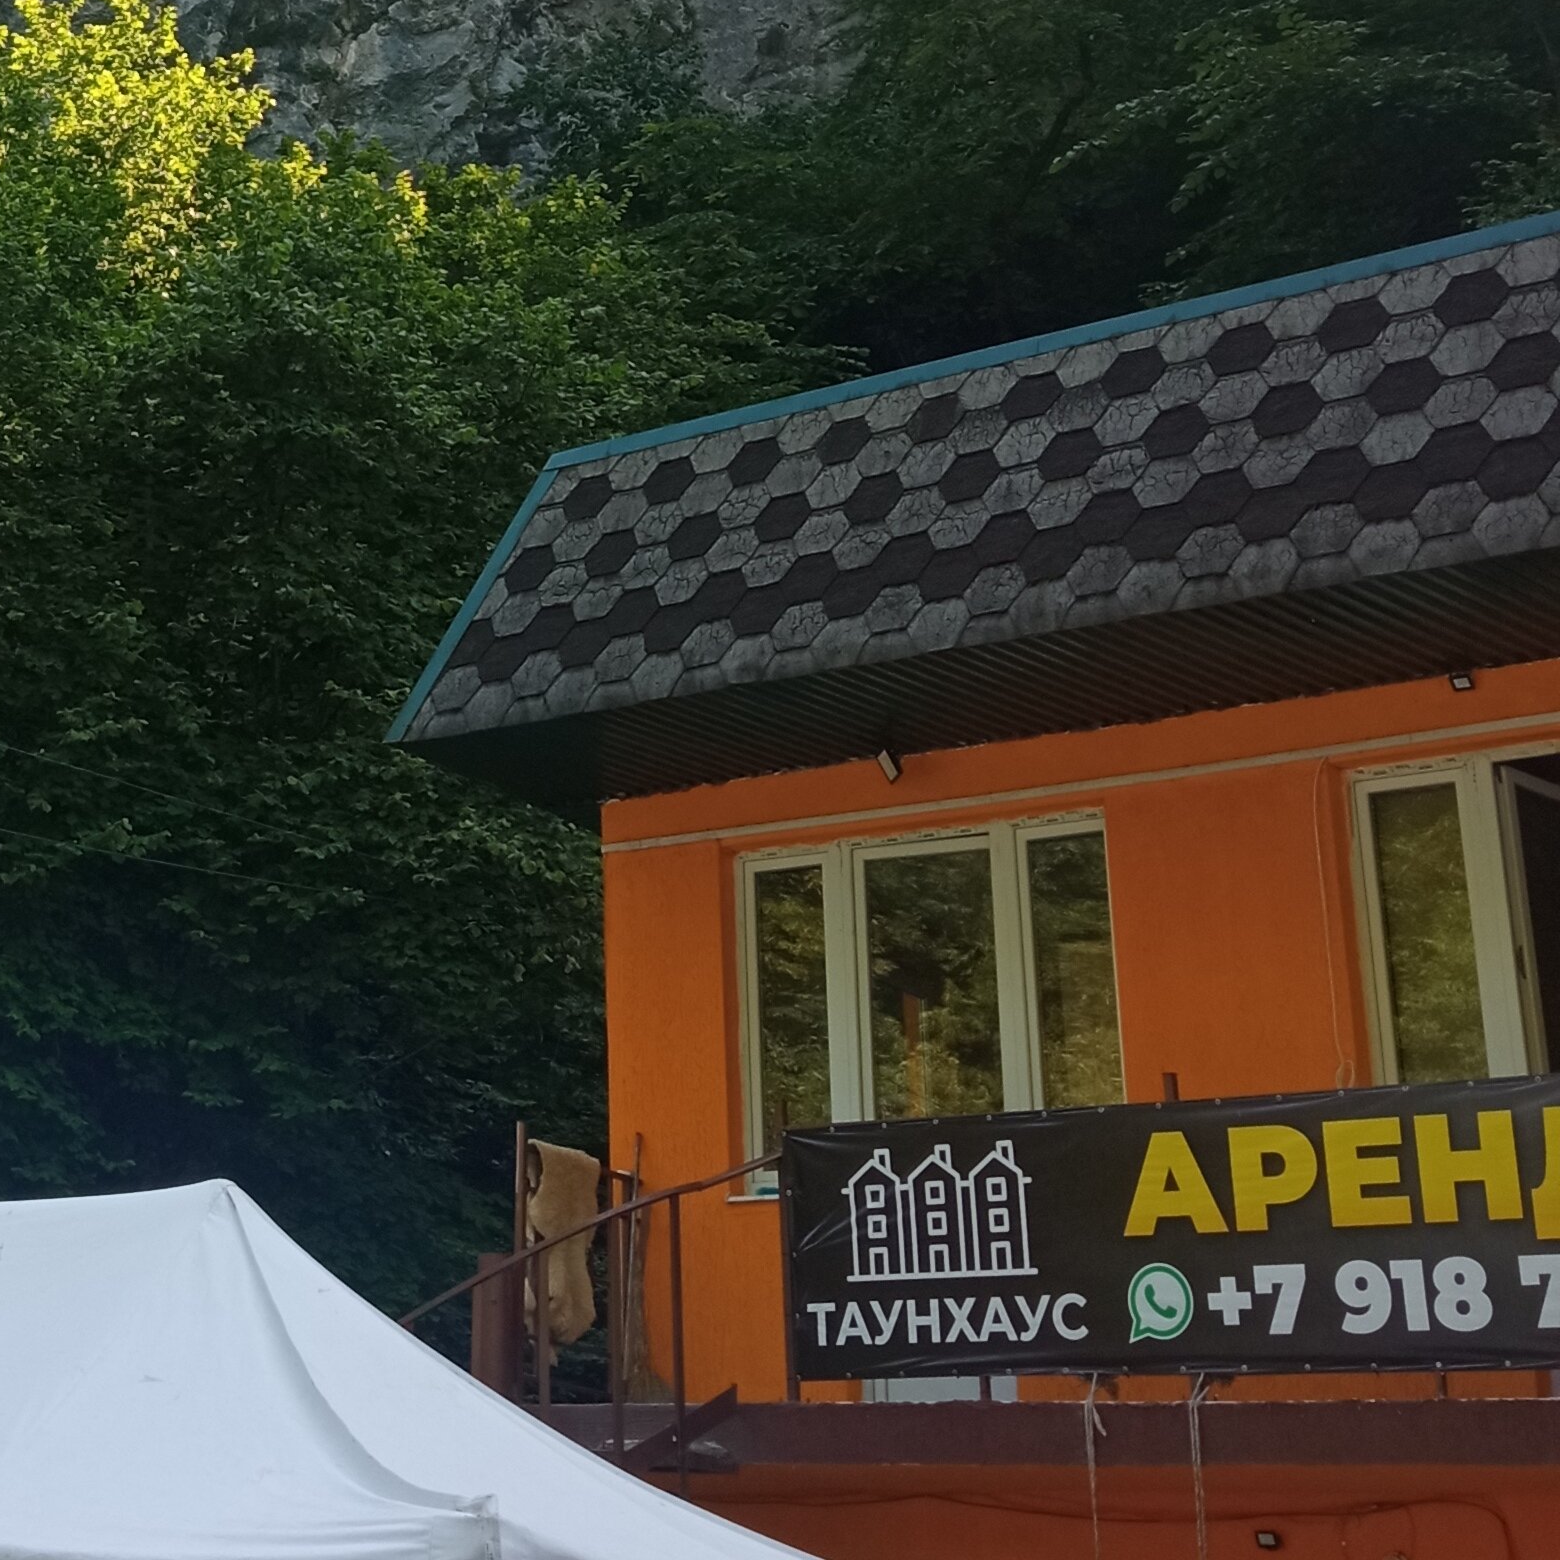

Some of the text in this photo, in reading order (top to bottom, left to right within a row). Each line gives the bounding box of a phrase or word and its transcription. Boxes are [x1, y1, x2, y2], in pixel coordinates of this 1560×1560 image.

[1124, 1107, 1560, 1240] АРЕН
[808, 1293, 1089, 1346] ТАУНХАУС
[1207, 1264, 1307, 1335] +7
[1335, 1257, 1493, 1335] 918
